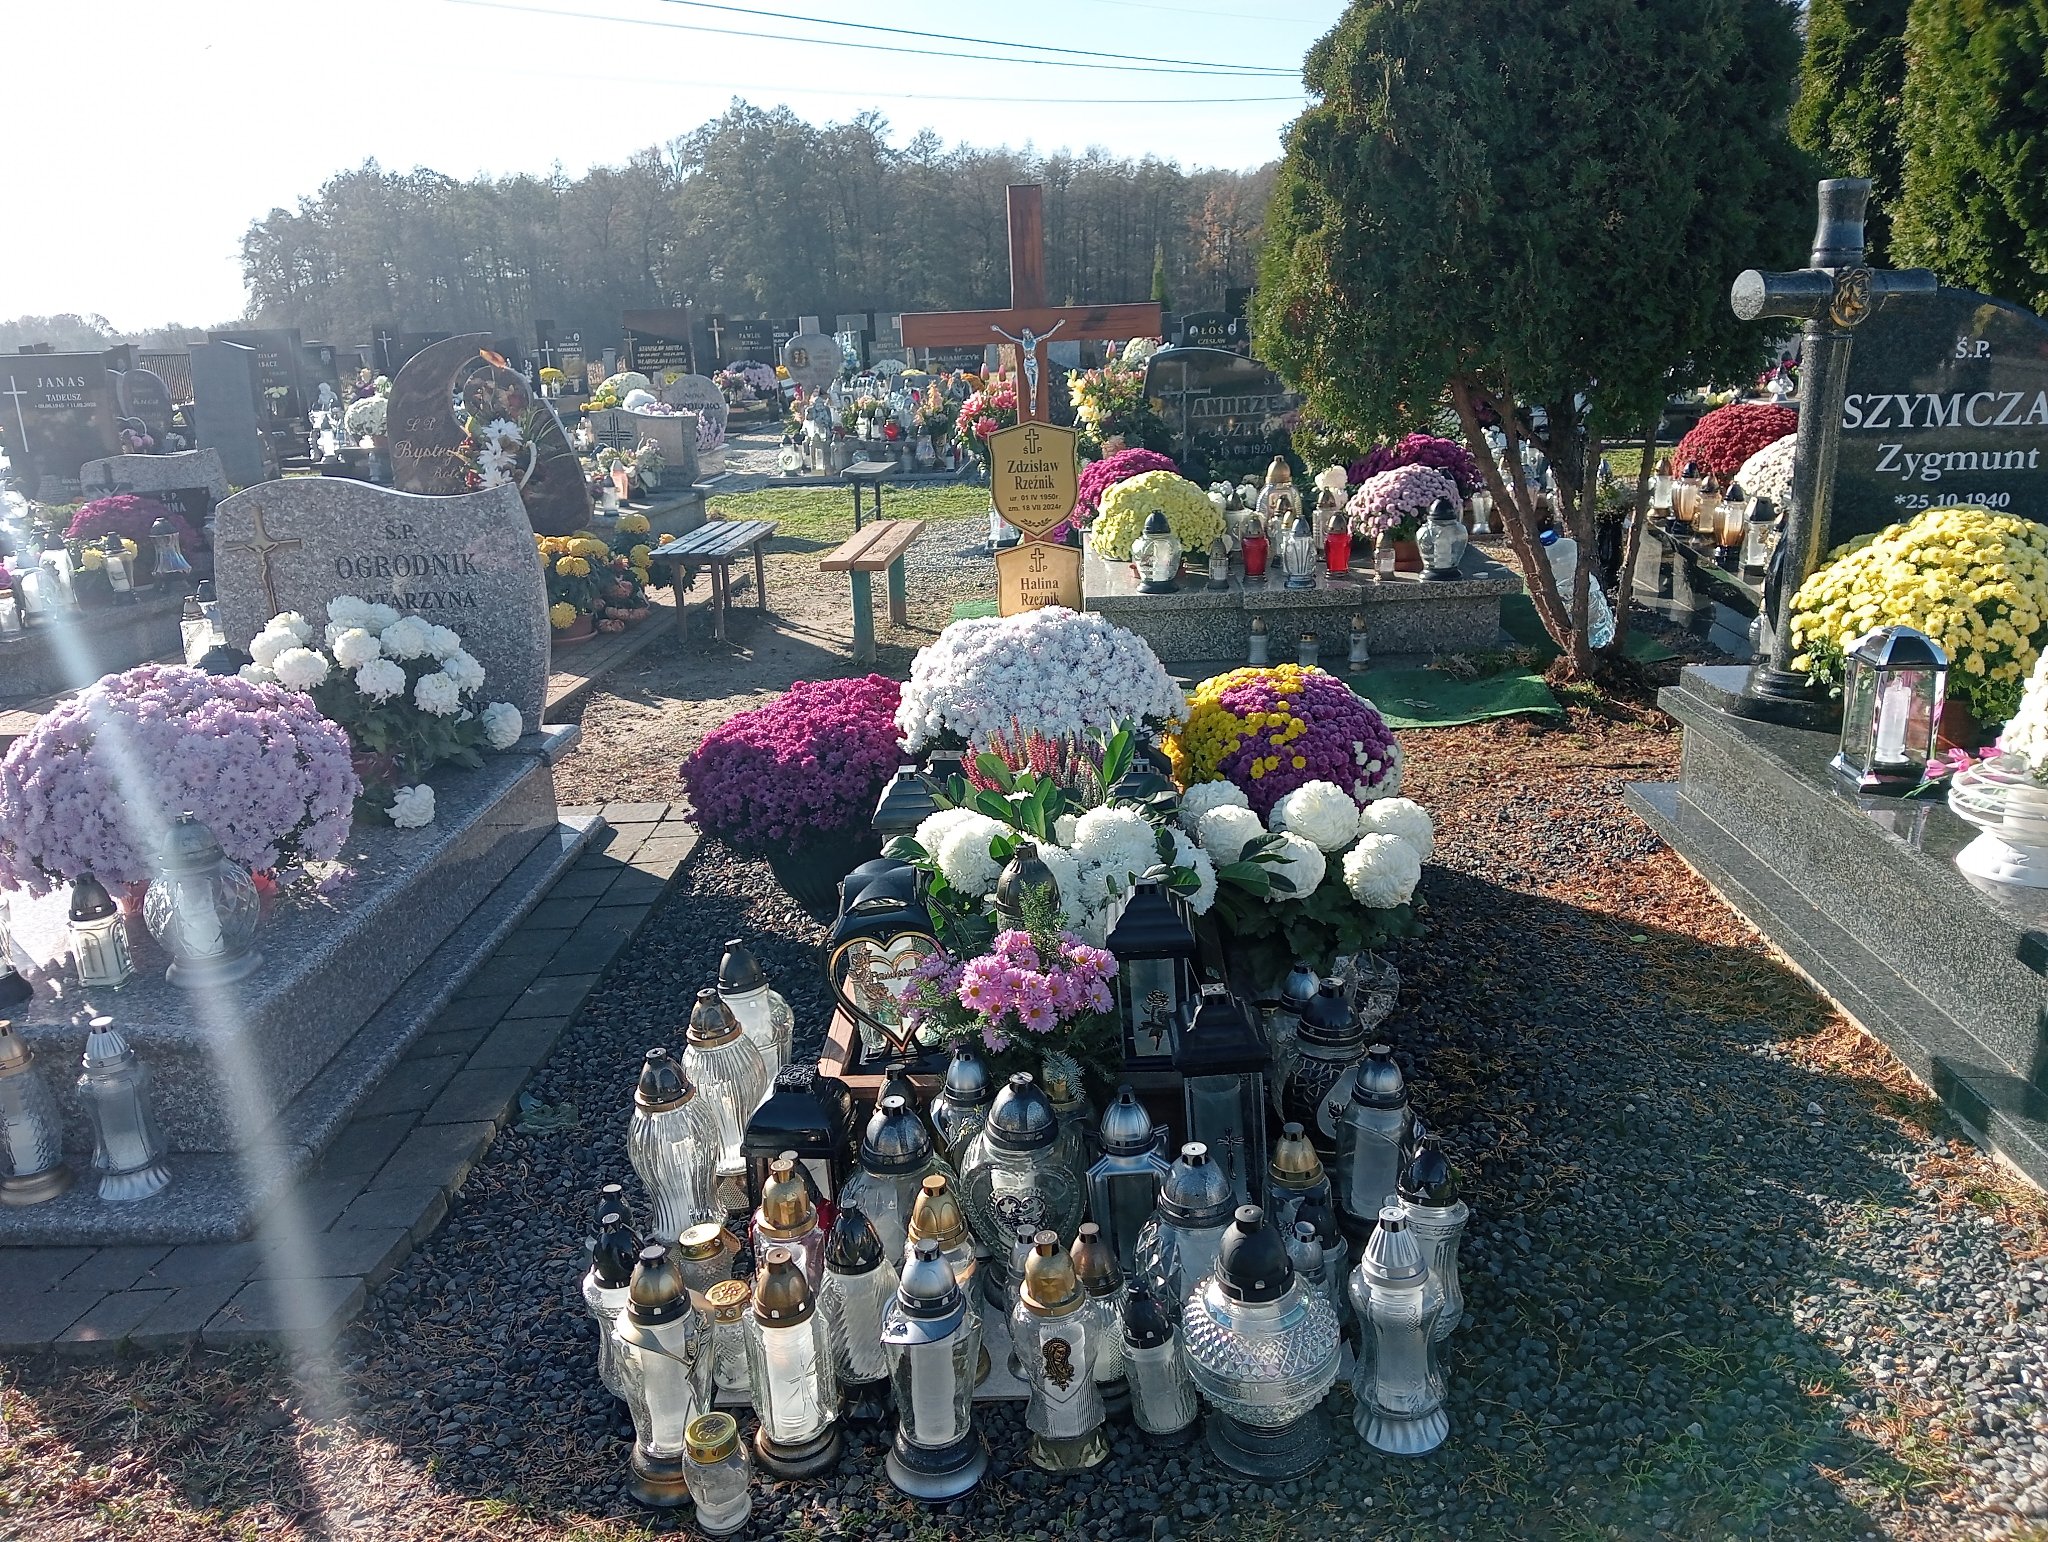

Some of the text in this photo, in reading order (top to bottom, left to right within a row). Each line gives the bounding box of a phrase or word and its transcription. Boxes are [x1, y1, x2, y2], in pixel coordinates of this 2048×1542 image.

[37, 376, 85, 388] JANAS
[45, 393, 82, 402] TADEUSZ
[1842, 390, 2048, 429] SZYMCZA
[1875, 443, 2040, 482] Zygmunt
[1014, 475, 1055, 490] Rzeźnik
[336, 553, 479, 579] OGRODNIK
[1020, 577, 1060, 590] Halina
[349, 591, 477, 610] ATARZYNA
[1021, 592, 1060, 606] Rzeźnik
